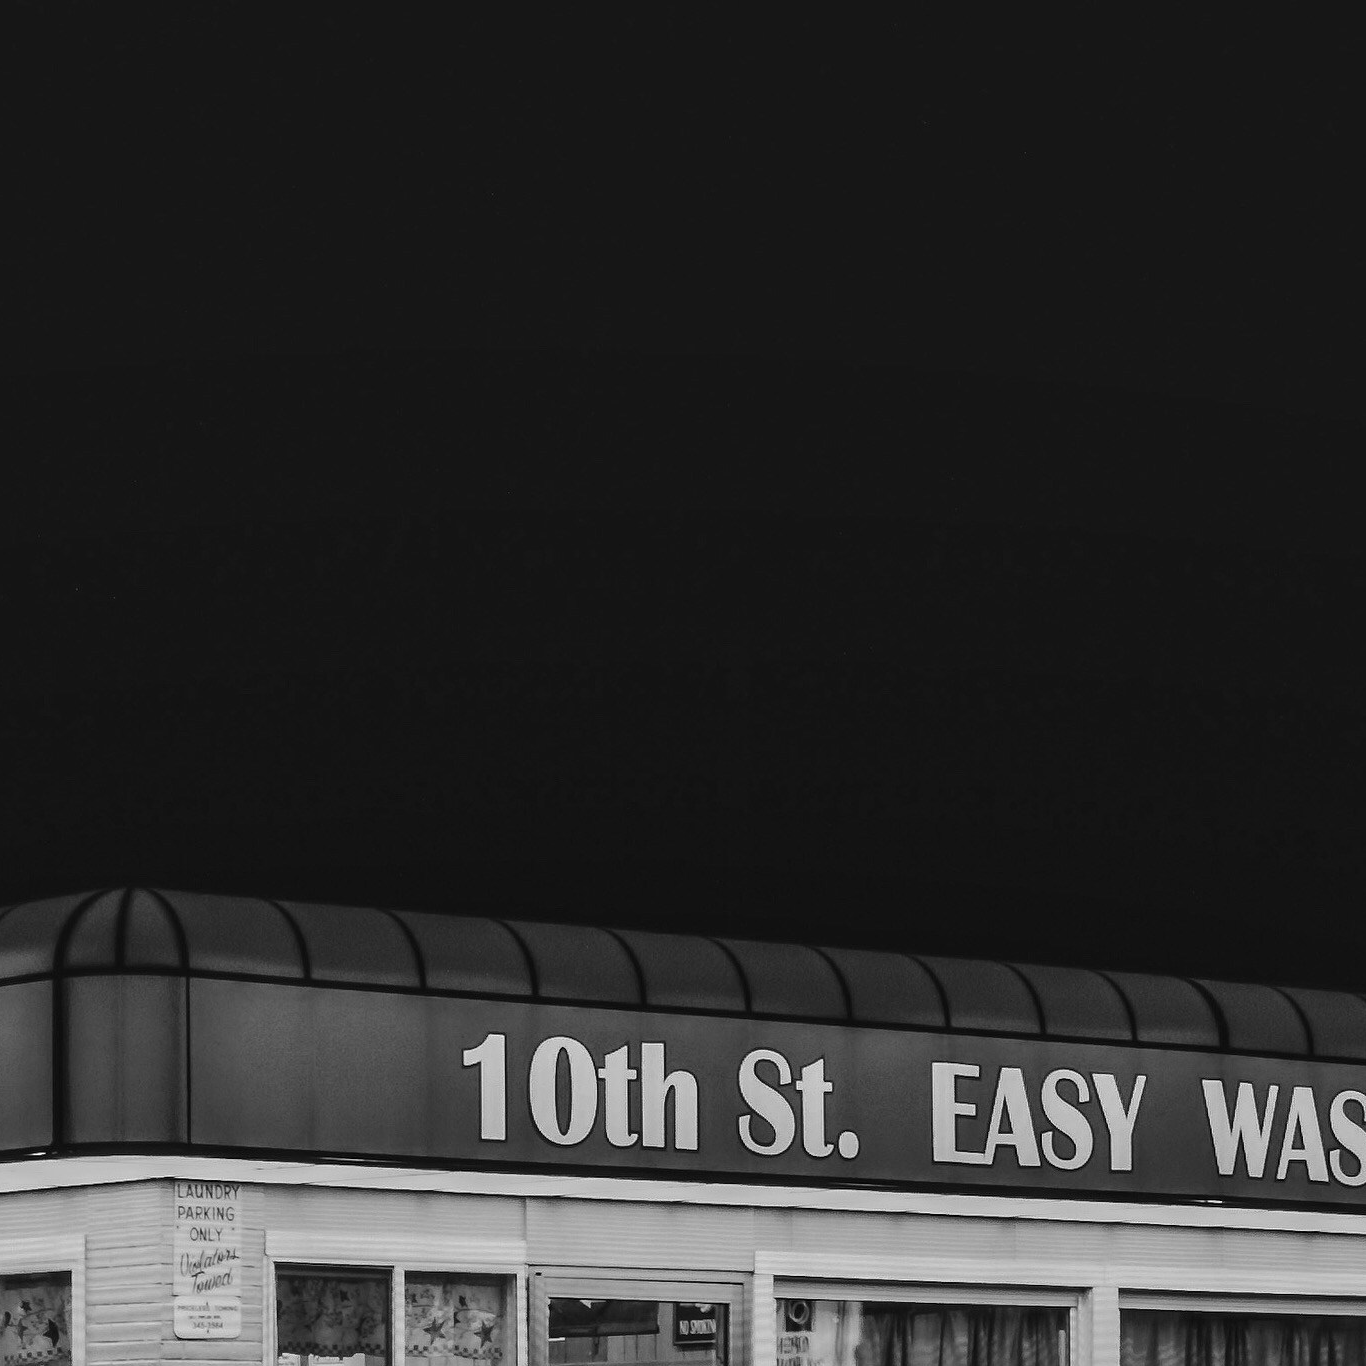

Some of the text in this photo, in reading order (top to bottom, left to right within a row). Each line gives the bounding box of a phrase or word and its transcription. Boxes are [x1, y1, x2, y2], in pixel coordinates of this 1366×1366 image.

[462, 1033, 699, 1151] 10th
[738, 1049, 860, 1159] St.
[931, 1062, 1148, 1172] EASY
[177, 1183, 241, 1200] LAUNDRY
[177, 1205, 235, 1221] PARKING
[189, 1227, 223, 1242] ONLY
[191, 1268, 233, 1293] Towed
